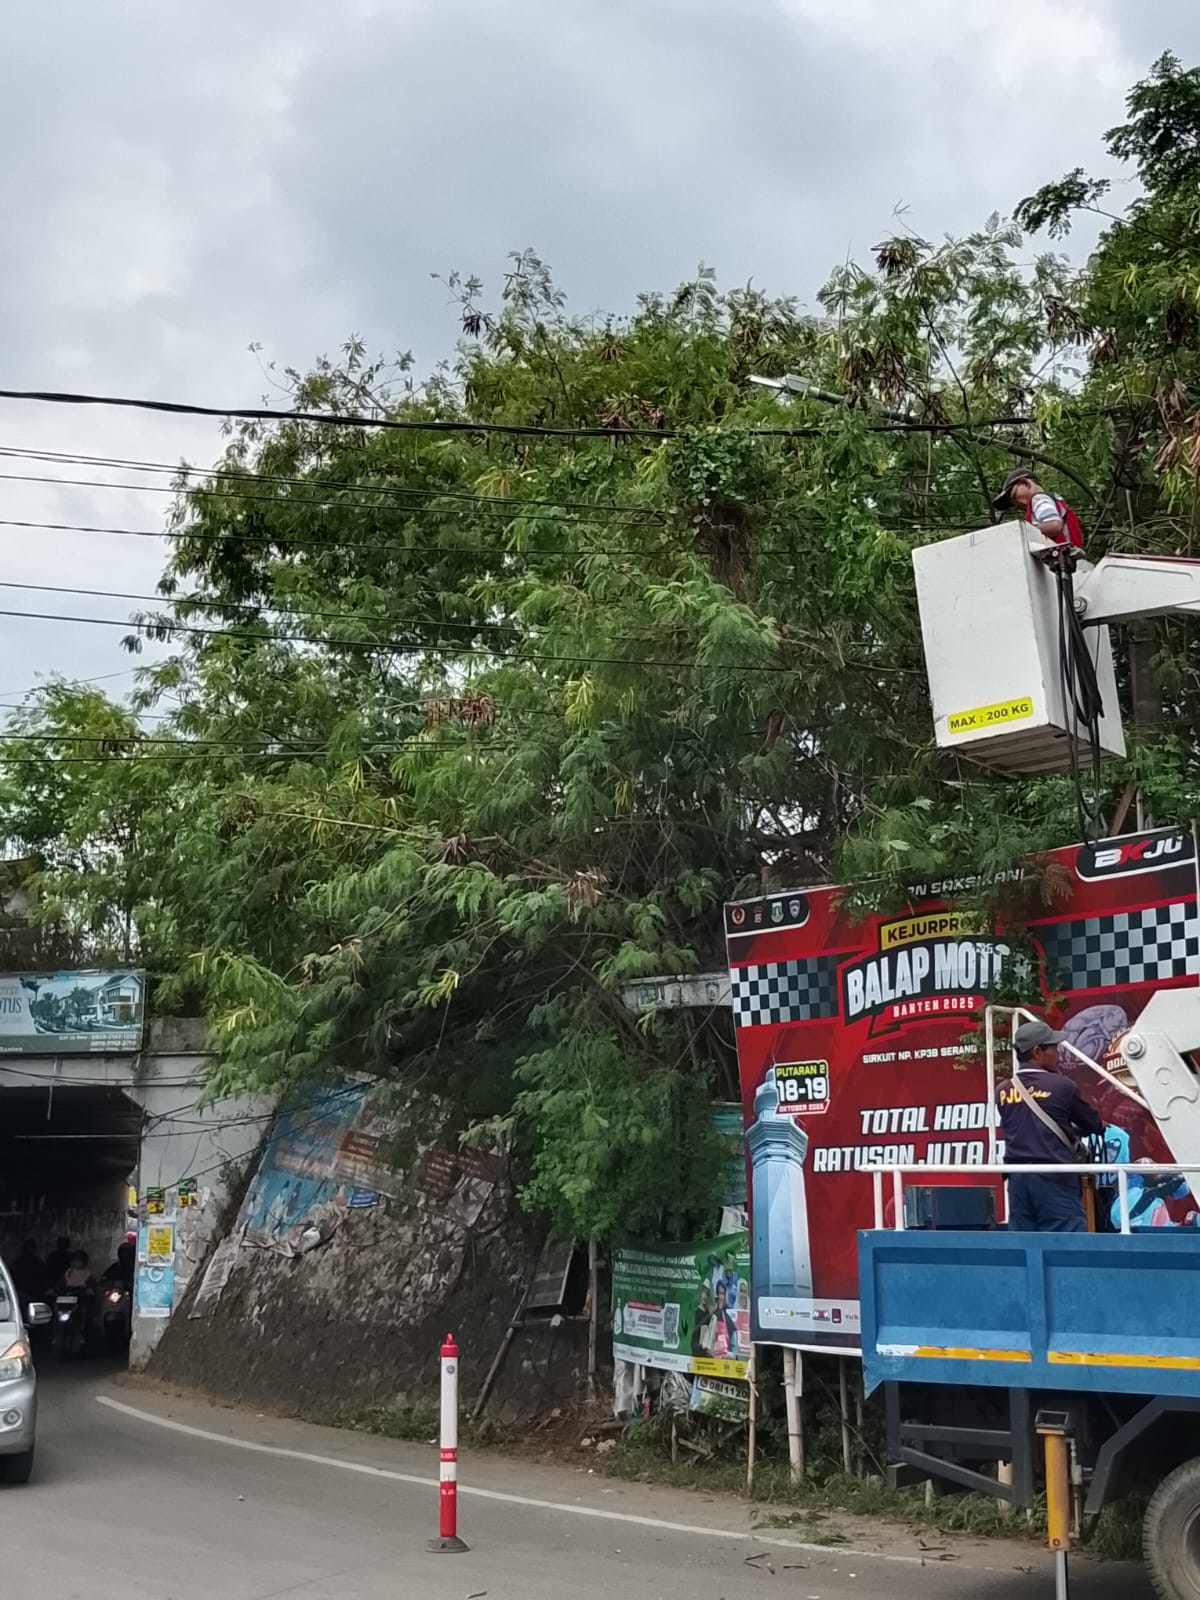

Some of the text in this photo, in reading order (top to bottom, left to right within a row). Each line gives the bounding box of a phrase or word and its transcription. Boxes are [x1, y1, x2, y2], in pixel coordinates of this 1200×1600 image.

[950, 715, 976, 729] MAX
[987, 708, 1008, 720] 200
[1011, 703, 1029, 715] KG
[847, 946, 930, 1017] BALAP
[893, 996, 974, 1018] BANTEN 2025
[863, 1052, 896, 1064] SIRKUIT
[940, 1044, 977, 1057] SERANG
[776, 1064, 826, 1078] PUTARAN 2
[777, 1077, 827, 1102] 18-19
[860, 1106, 930, 1135] TOTAL
[813, 1144, 915, 1173] RATUSAN
[918, 1141, 984, 1165] JUTA
